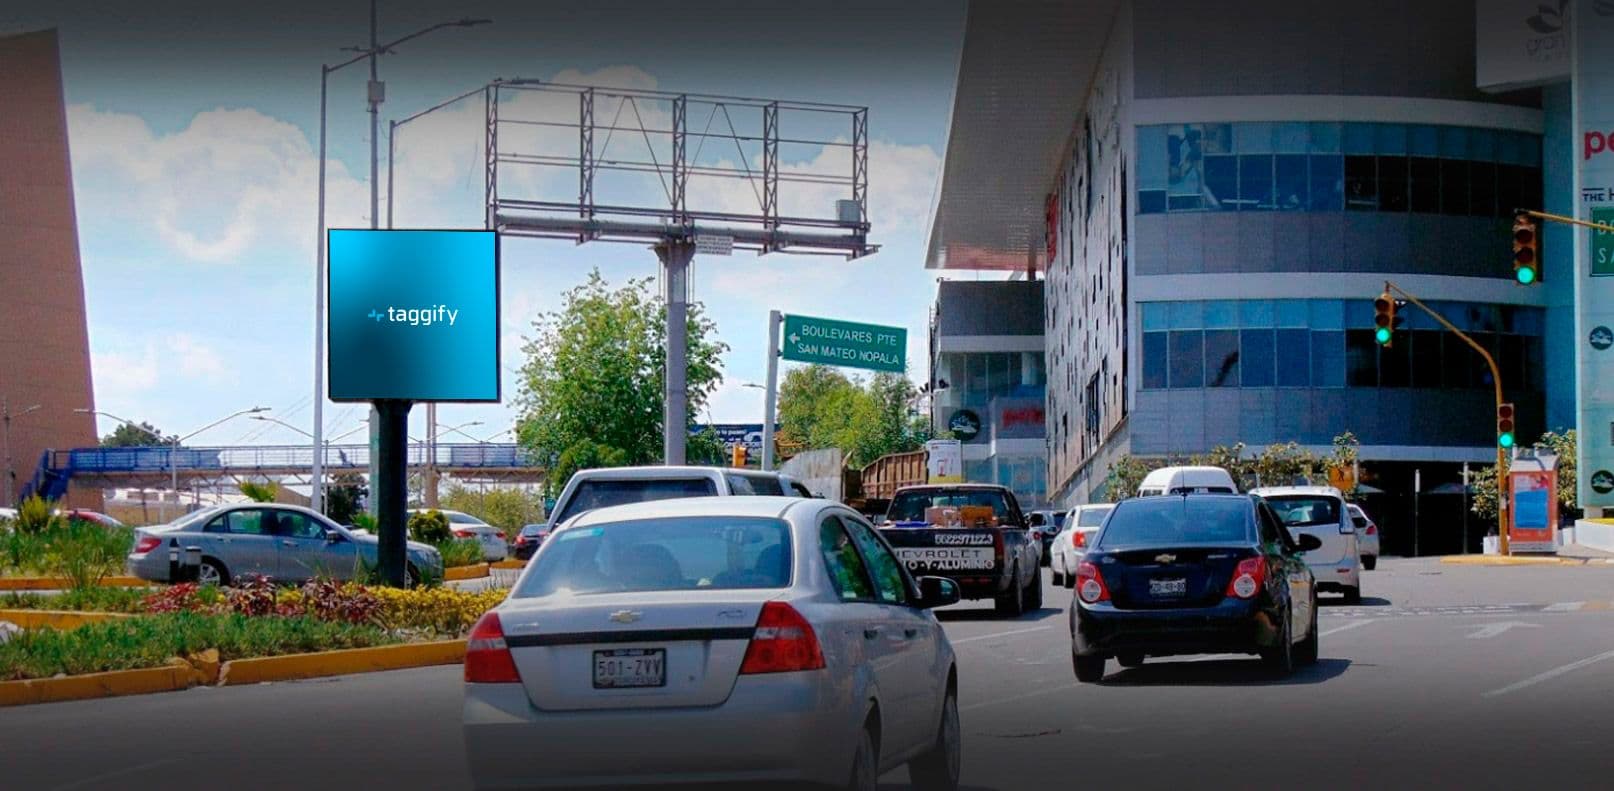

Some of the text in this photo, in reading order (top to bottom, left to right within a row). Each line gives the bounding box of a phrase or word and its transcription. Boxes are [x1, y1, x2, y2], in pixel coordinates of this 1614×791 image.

[1582, 193, 1604, 201] THE
[387, 304, 459, 326] taggify
[802, 325, 897, 346] BOULEVARES PTE
[798, 343, 900, 365] SAN MATEO NOPALA
